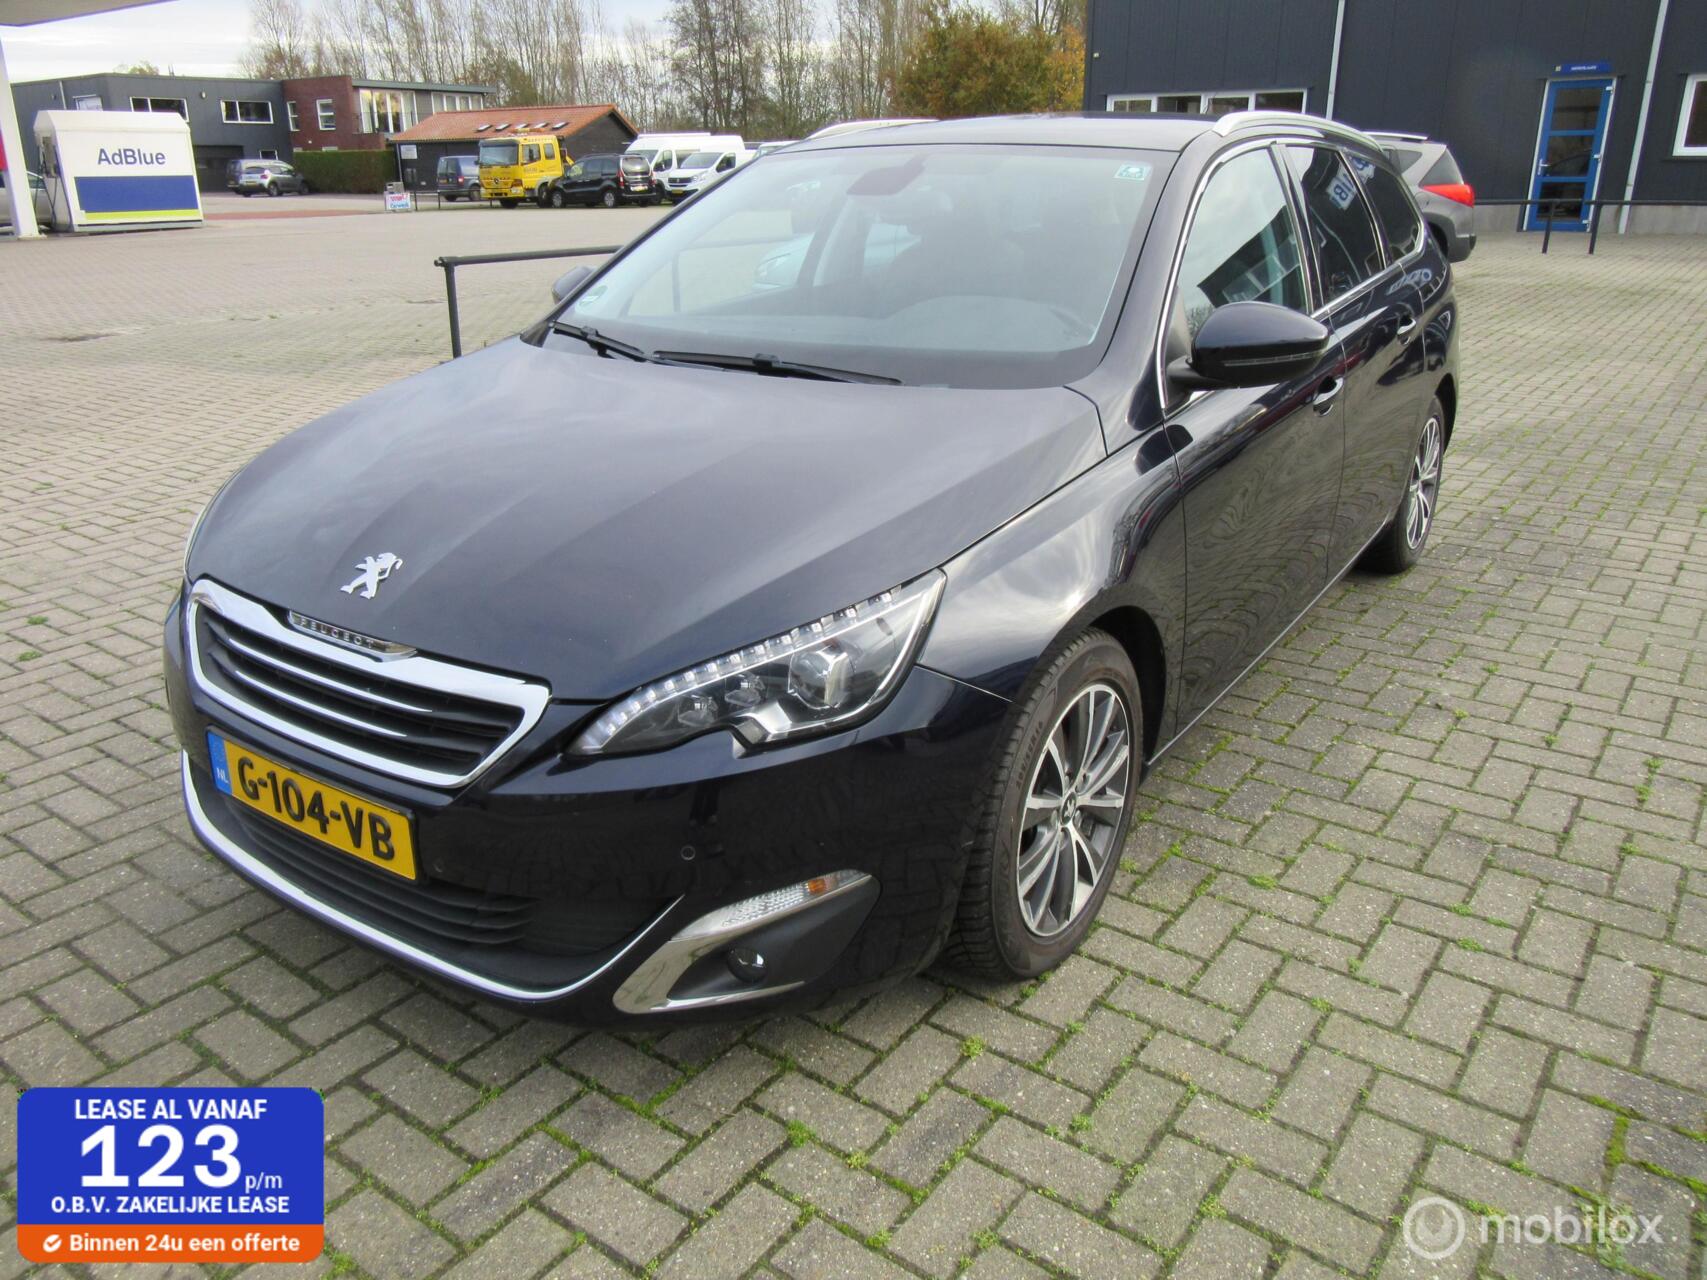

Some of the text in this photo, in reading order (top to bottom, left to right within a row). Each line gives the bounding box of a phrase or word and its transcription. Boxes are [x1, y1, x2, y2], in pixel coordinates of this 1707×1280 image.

[97, 148, 166, 165] AdBlue
[300, 616, 374, 649] PEUGEOT
[216, 767, 229, 783] NL
[237, 756, 395, 861] G-104-VB
